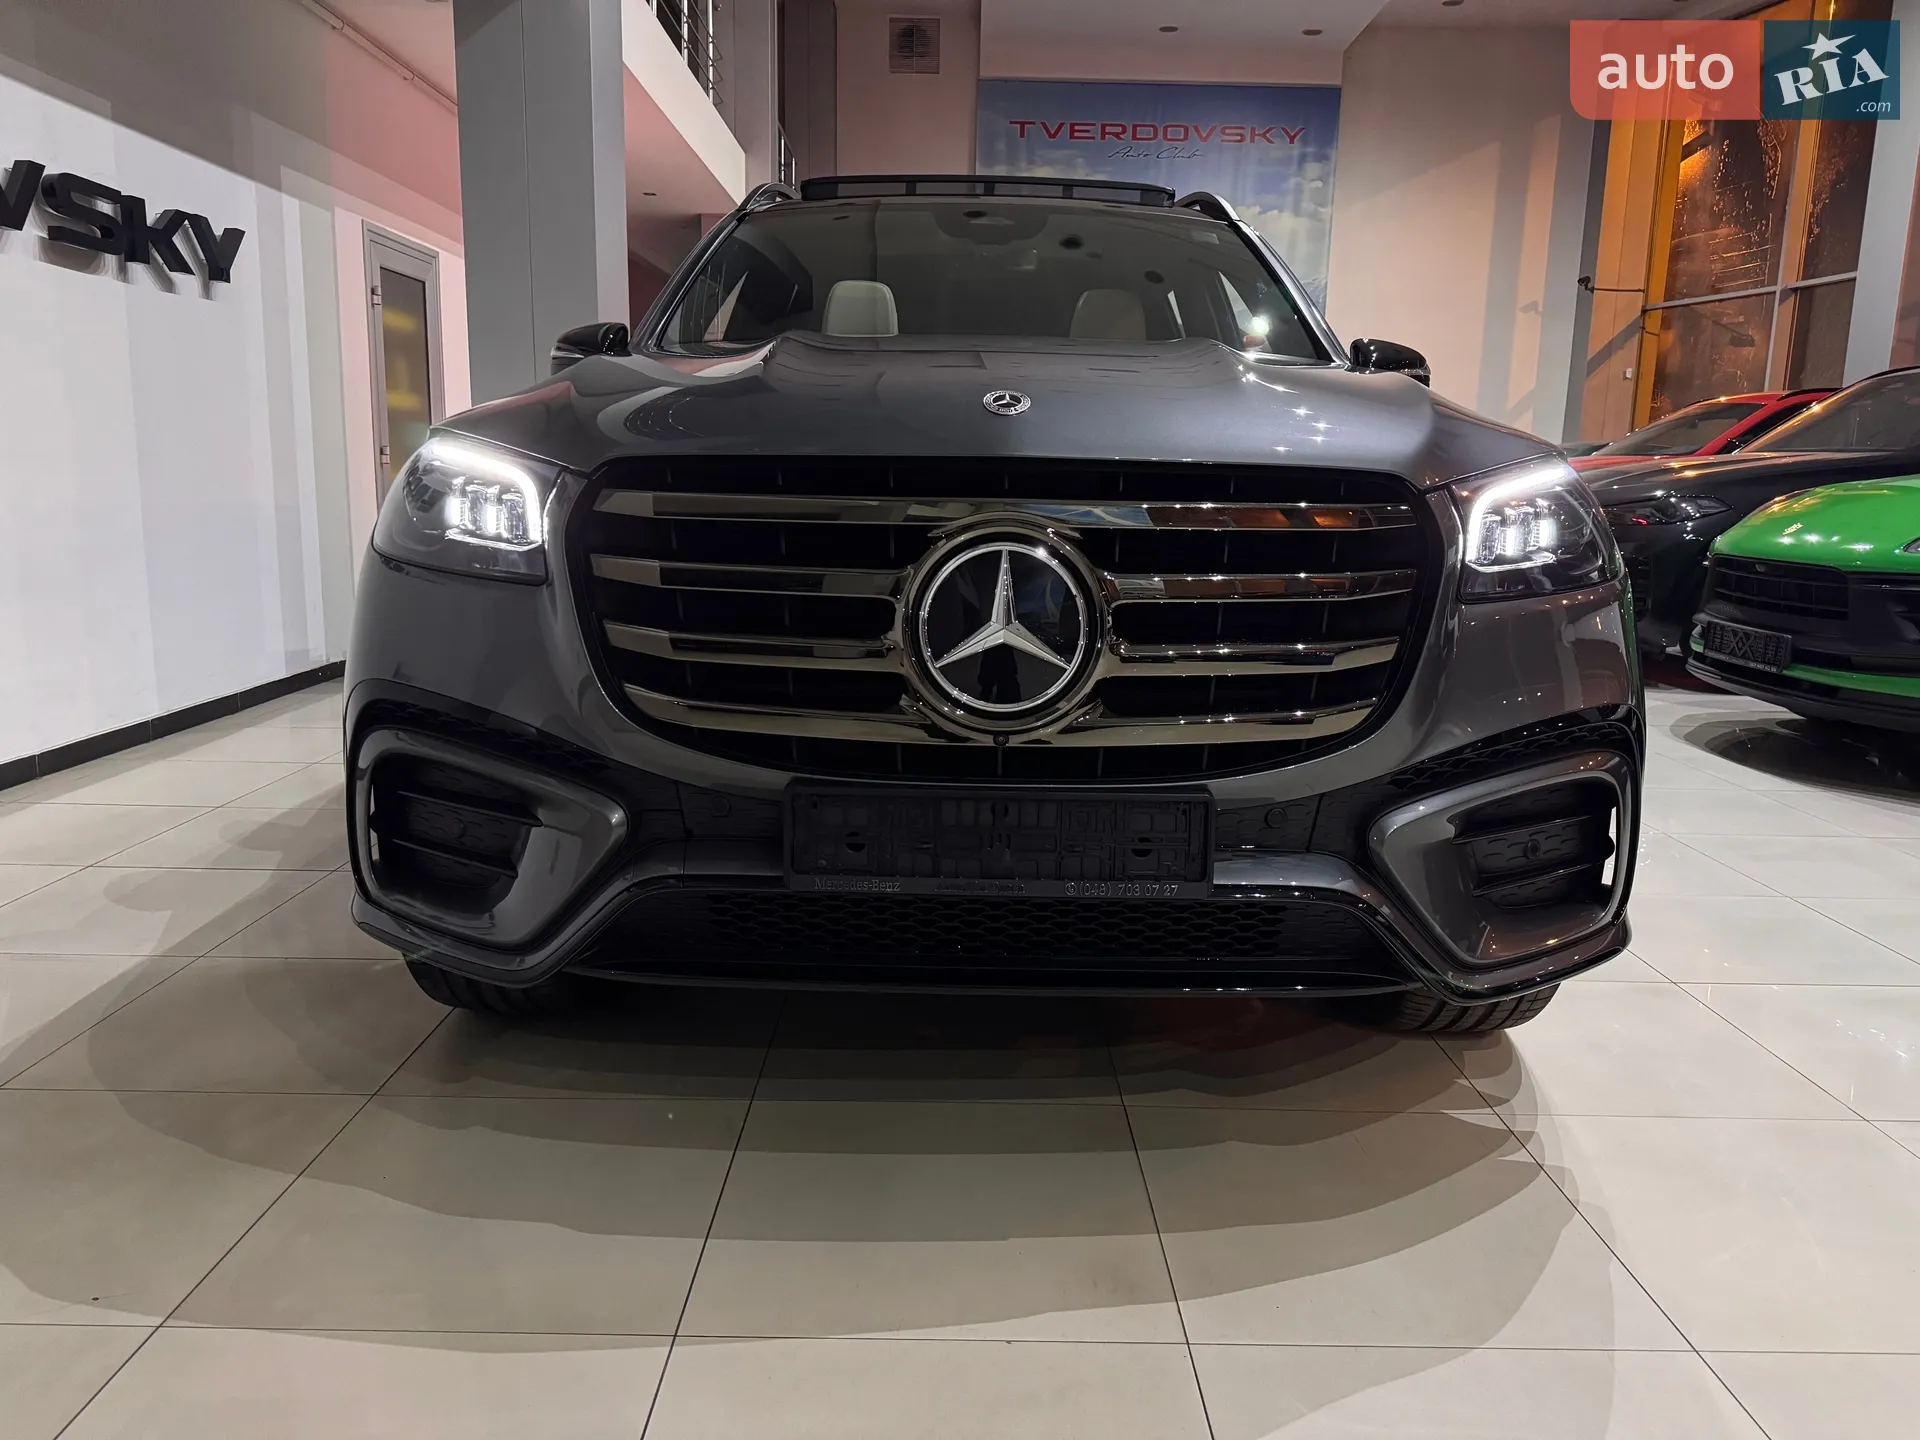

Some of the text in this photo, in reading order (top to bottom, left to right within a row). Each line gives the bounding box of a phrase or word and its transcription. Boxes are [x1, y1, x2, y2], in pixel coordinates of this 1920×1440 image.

[1009, 120, 1306, 145] TVERDOVSKY
[1107, 145, 1203, 159] Auto Club
[814, 877, 900, 892] Mercedes-Benz
[1144, 884, 1159, 896] 07
[1163, 884, 1179, 896] 27
